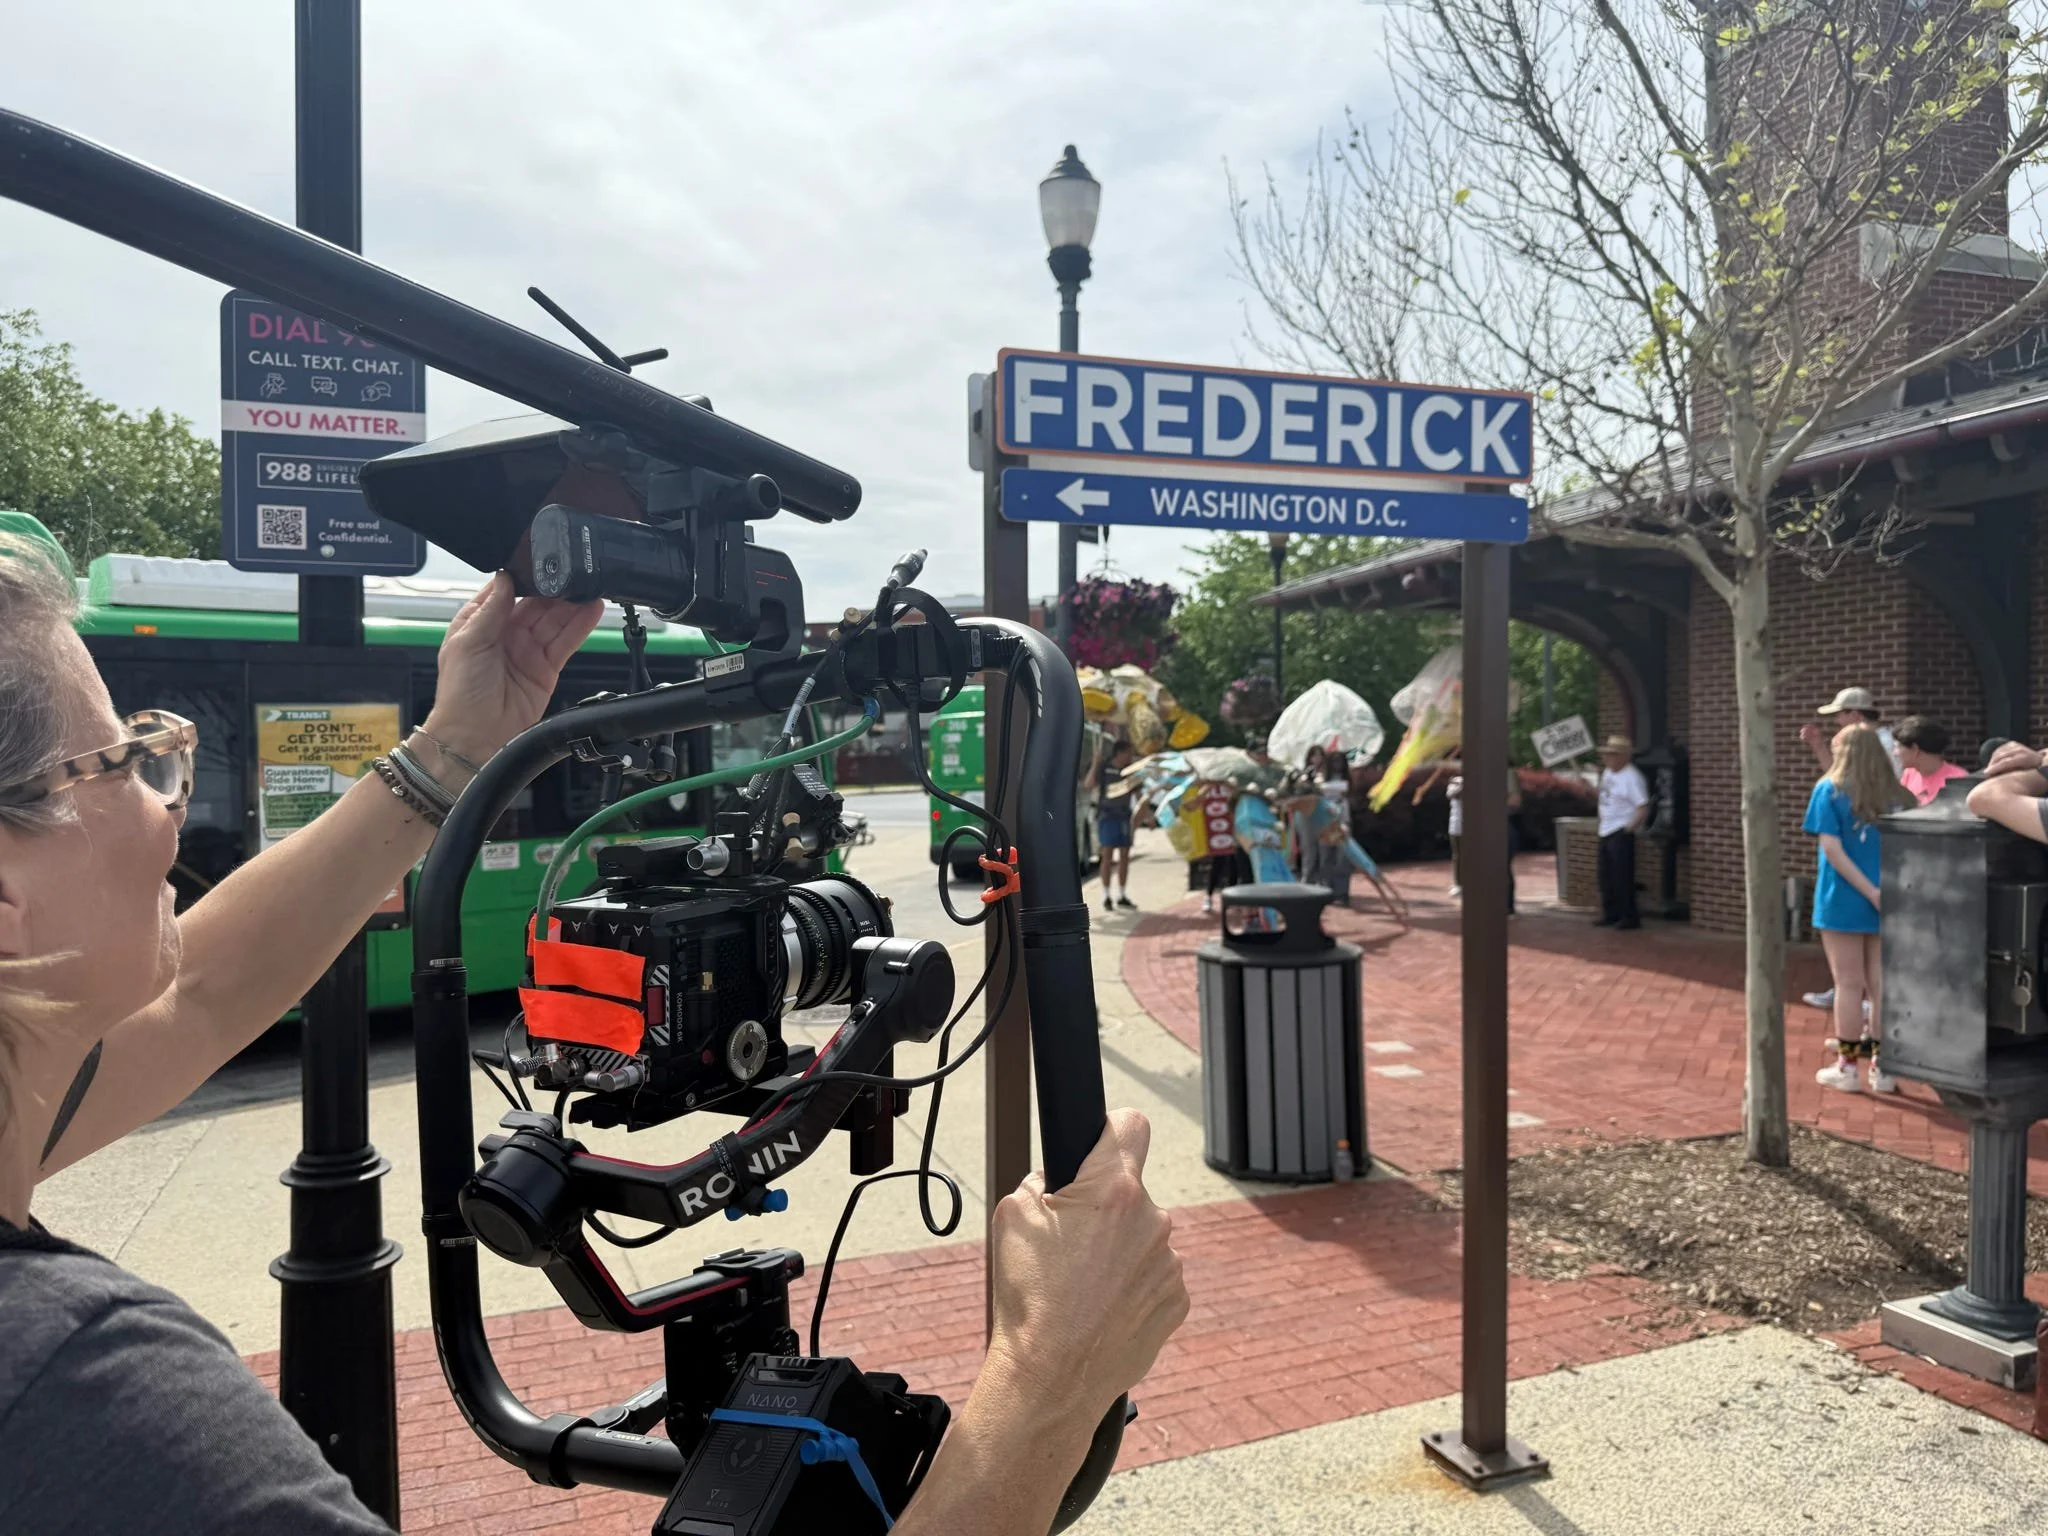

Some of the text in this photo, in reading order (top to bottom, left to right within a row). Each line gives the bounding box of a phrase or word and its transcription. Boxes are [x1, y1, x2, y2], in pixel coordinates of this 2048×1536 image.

[249, 313, 328, 344] DIAL
[248, 351, 403, 375] CALL. TEXT. CHAT.
[247, 408, 406, 436] YOU MATTER.
[1014, 361, 1521, 475] FREDERICK
[265, 461, 312, 482] 988
[316, 472, 357, 485] LIFEL
[1150, 487, 1407, 527] WASHINGTON D.C.
[328, 518, 380, 530] Free and
[318, 531, 393, 544] Confidential.
[304, 723, 356, 733] DON'T
[287, 733, 372, 744] GET STUCK!
[278, 744, 298, 753] Get
[313, 743, 381, 754] guaranteed
[298, 753, 322, 761] ride
[265, 768, 329, 777] Guaranteed
[265, 775, 325, 784] Ride Home
[746, 1393, 798, 1408] NANO
